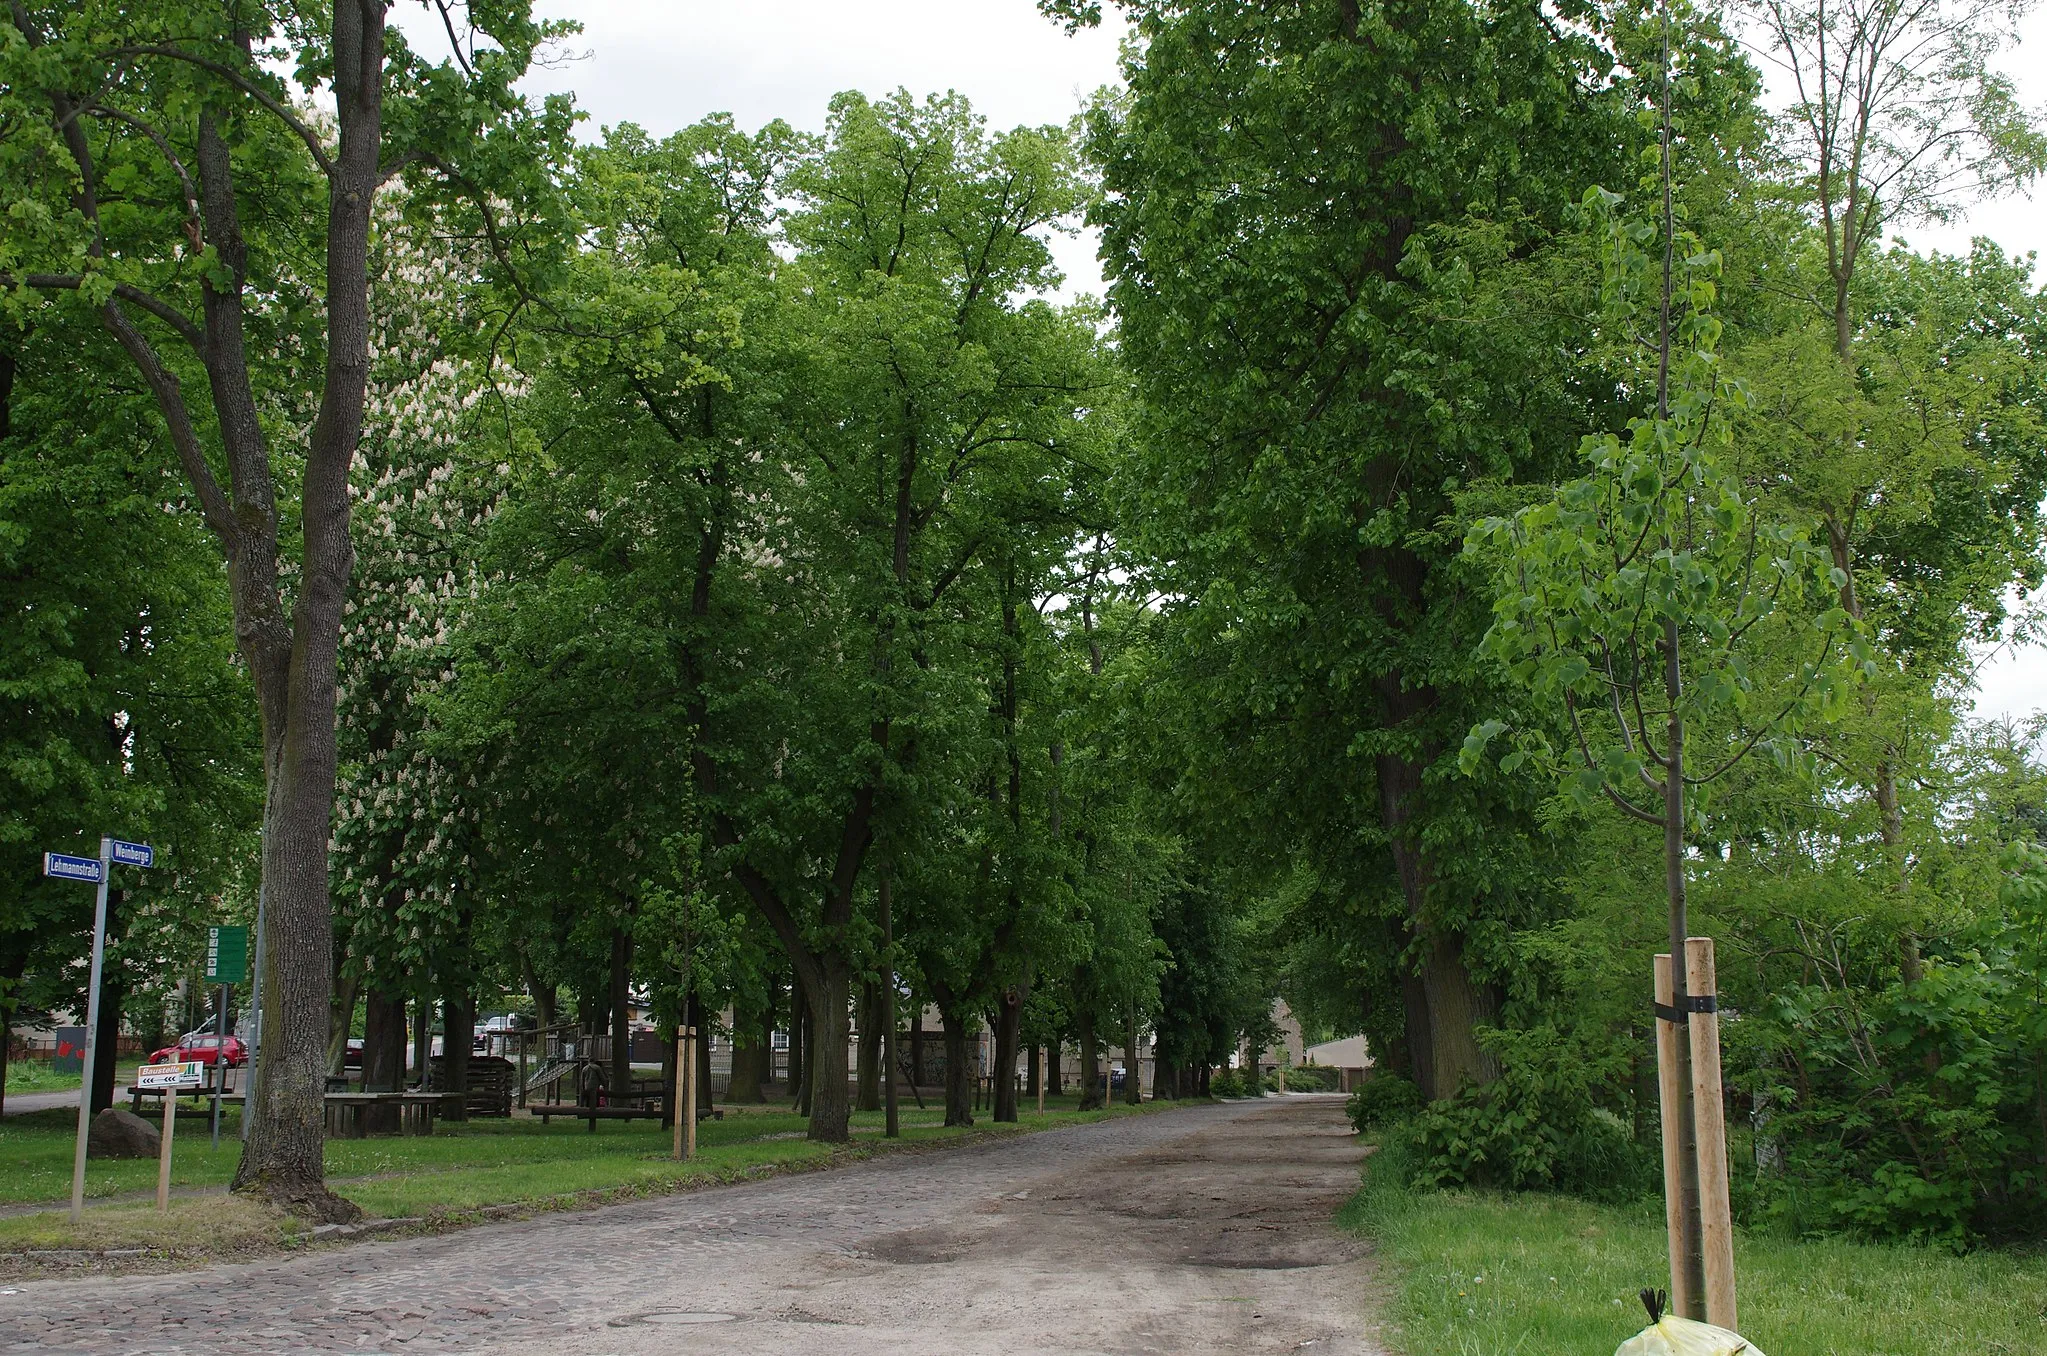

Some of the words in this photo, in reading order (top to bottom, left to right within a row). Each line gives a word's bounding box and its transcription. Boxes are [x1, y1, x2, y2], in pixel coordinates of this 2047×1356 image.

[115, 843, 149, 864] Weinberge
[51, 857, 99, 877] Lehmannstraße
[142, 1066, 179, 1075] Baustelle
